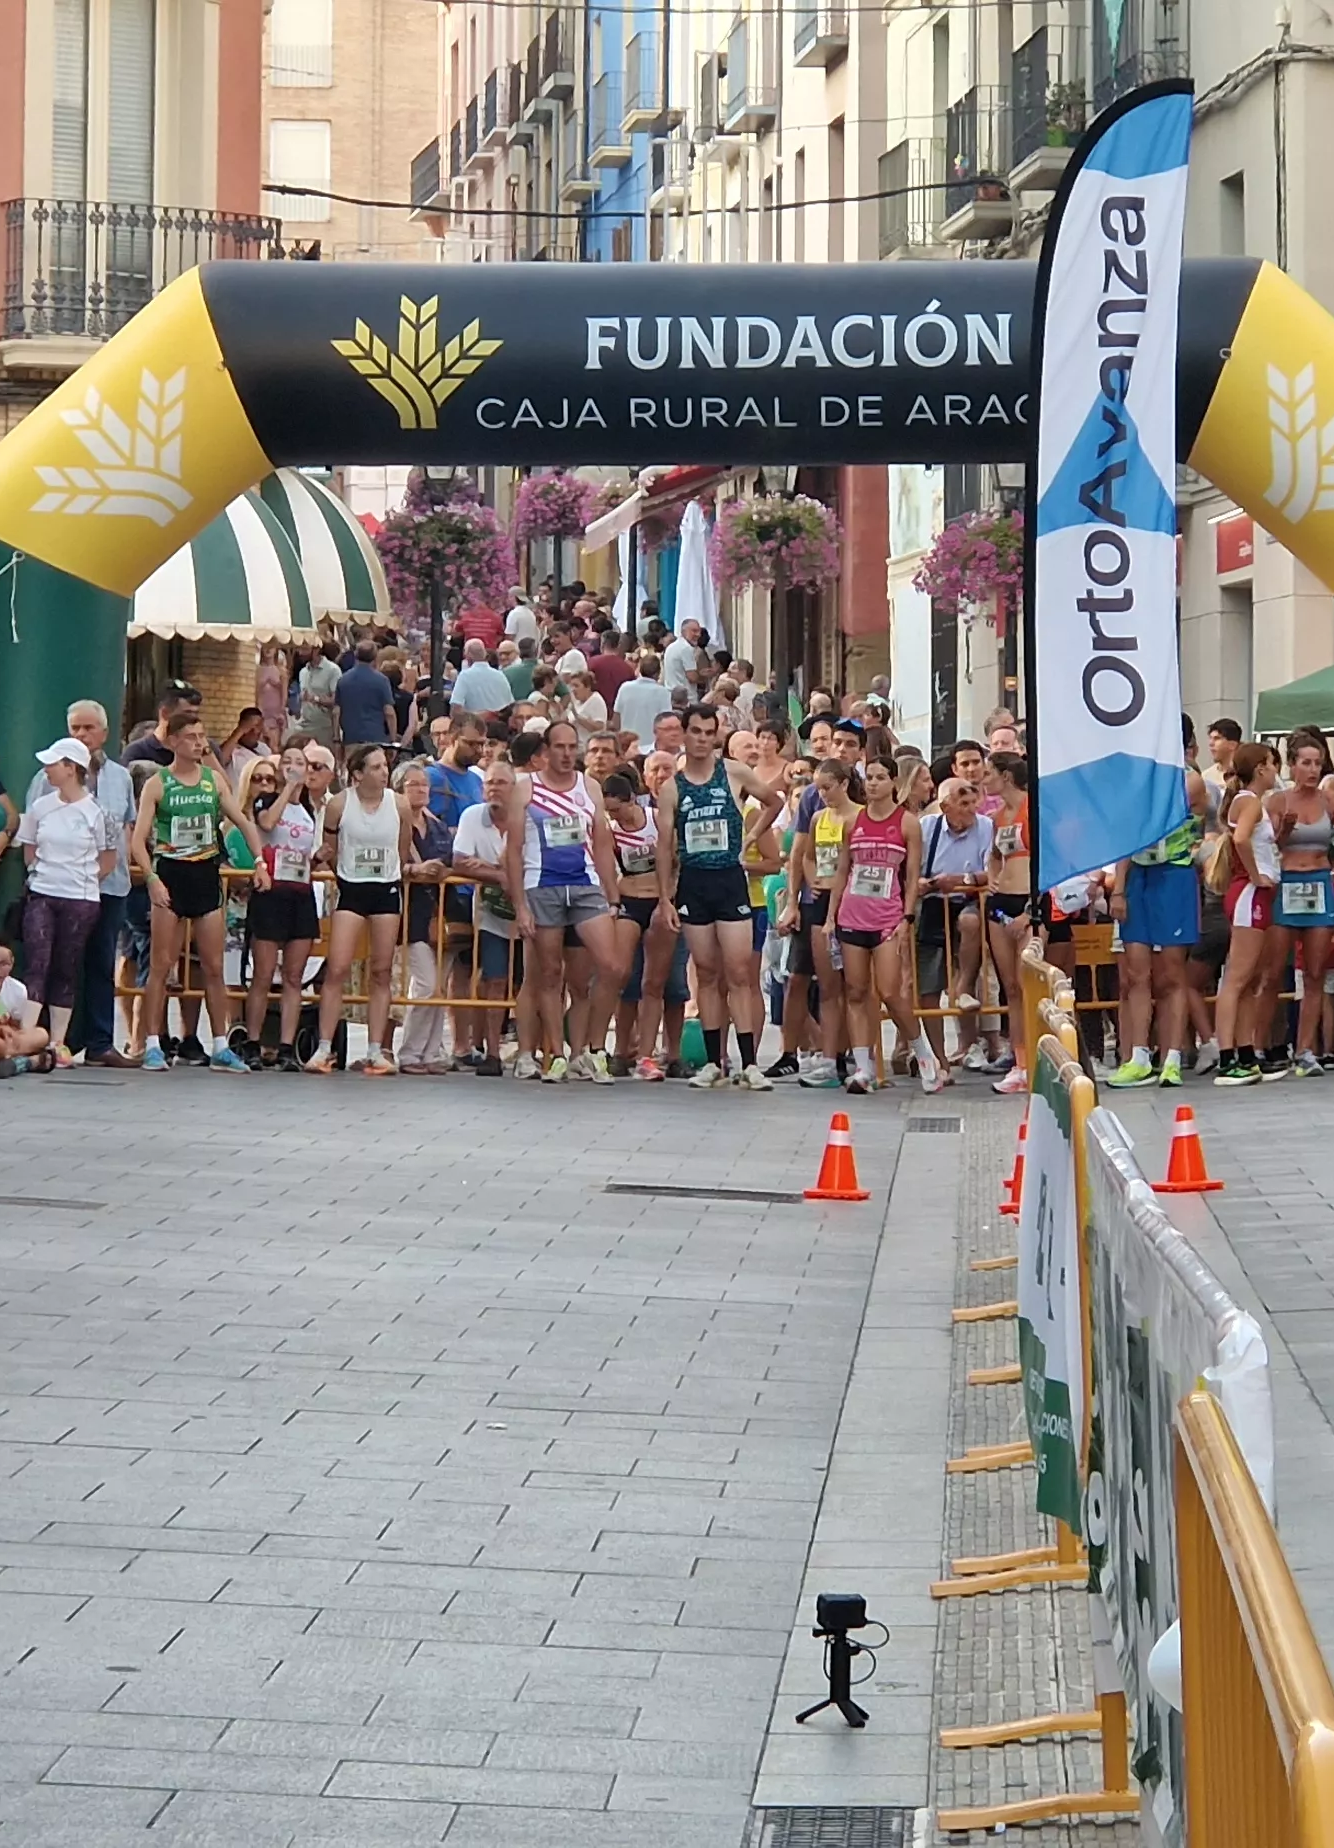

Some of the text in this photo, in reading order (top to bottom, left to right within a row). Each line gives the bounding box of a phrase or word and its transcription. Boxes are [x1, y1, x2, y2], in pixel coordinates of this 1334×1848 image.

[585, 298, 1012, 370] FUNDACIÓN
[475, 396, 606, 430] CAJA
[630, 395, 796, 429] RURAL
[820, 395, 882, 427] DE
[1076, 194, 1148, 727] OrtoAvanza
[863, 866, 880, 878] 25
